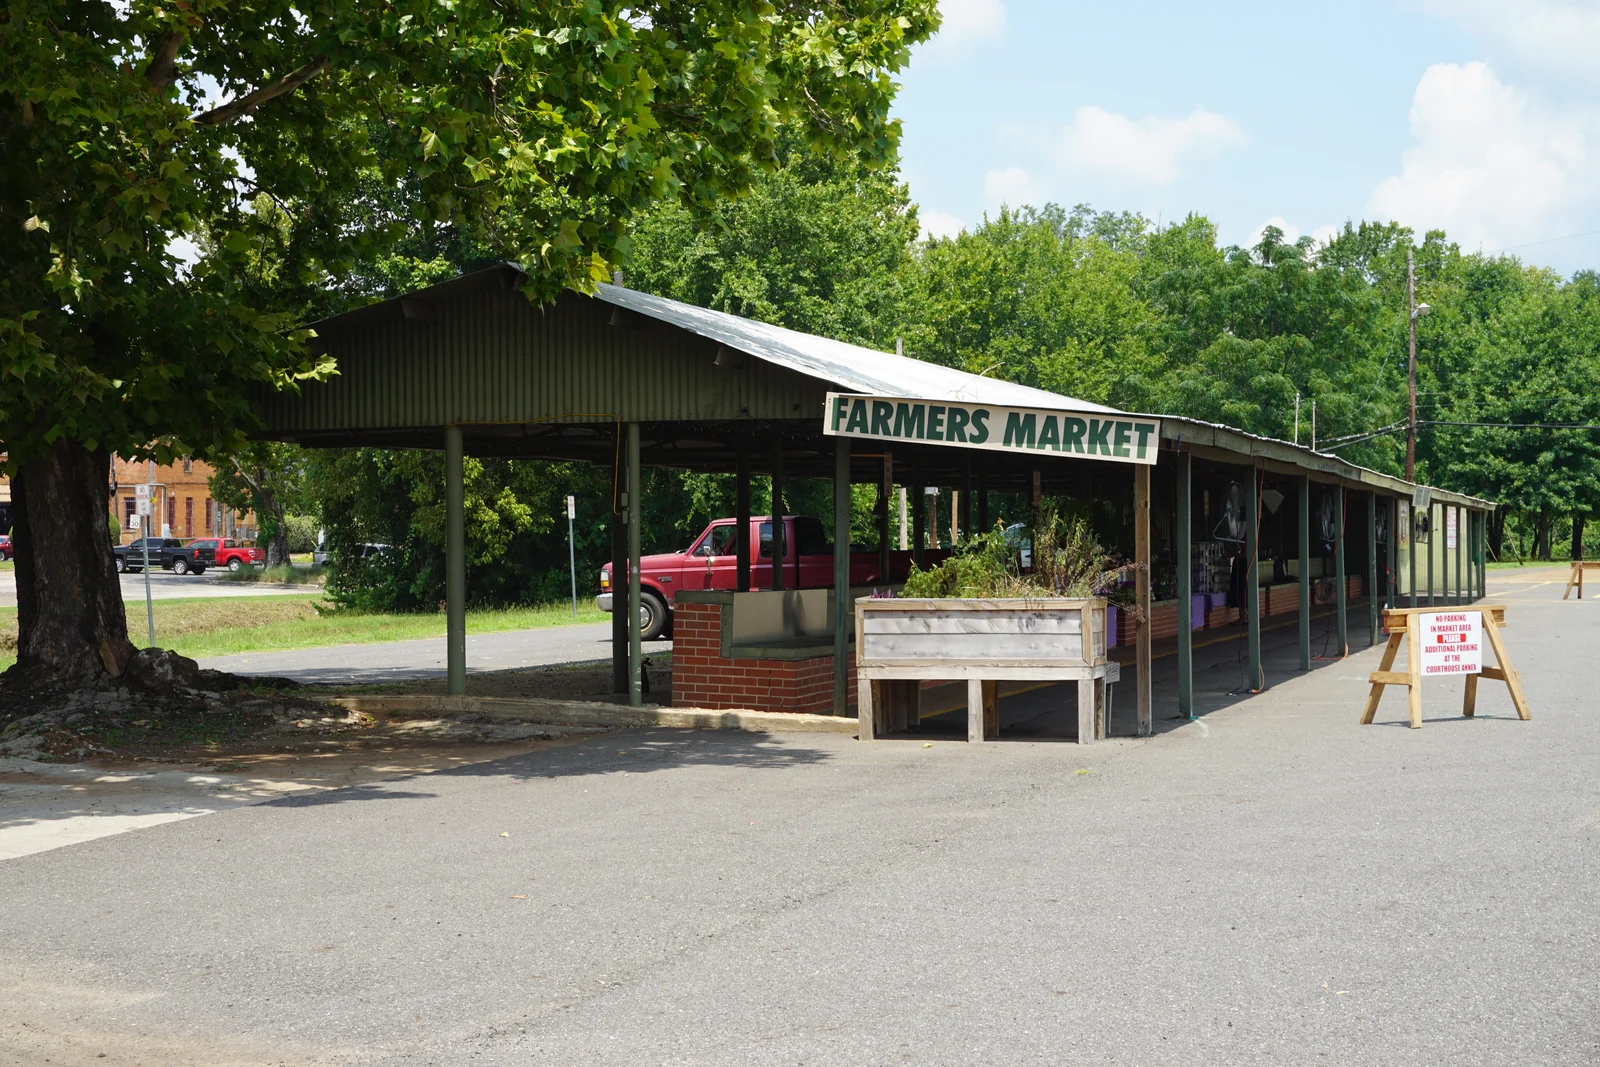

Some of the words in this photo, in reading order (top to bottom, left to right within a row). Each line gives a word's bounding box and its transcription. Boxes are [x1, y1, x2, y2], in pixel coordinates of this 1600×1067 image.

[831, 396, 990, 444] FARMERS
[1003, 412, 1155, 459] MARKET
[1444, 614, 1466, 622] PARKING
[1443, 634, 1461, 643] PLEASE
[1425, 645, 1455, 653] ADDITIONAL
[1457, 644, 1477, 652] PARKING
[1426, 665, 1460, 673] COURTHOUSE
